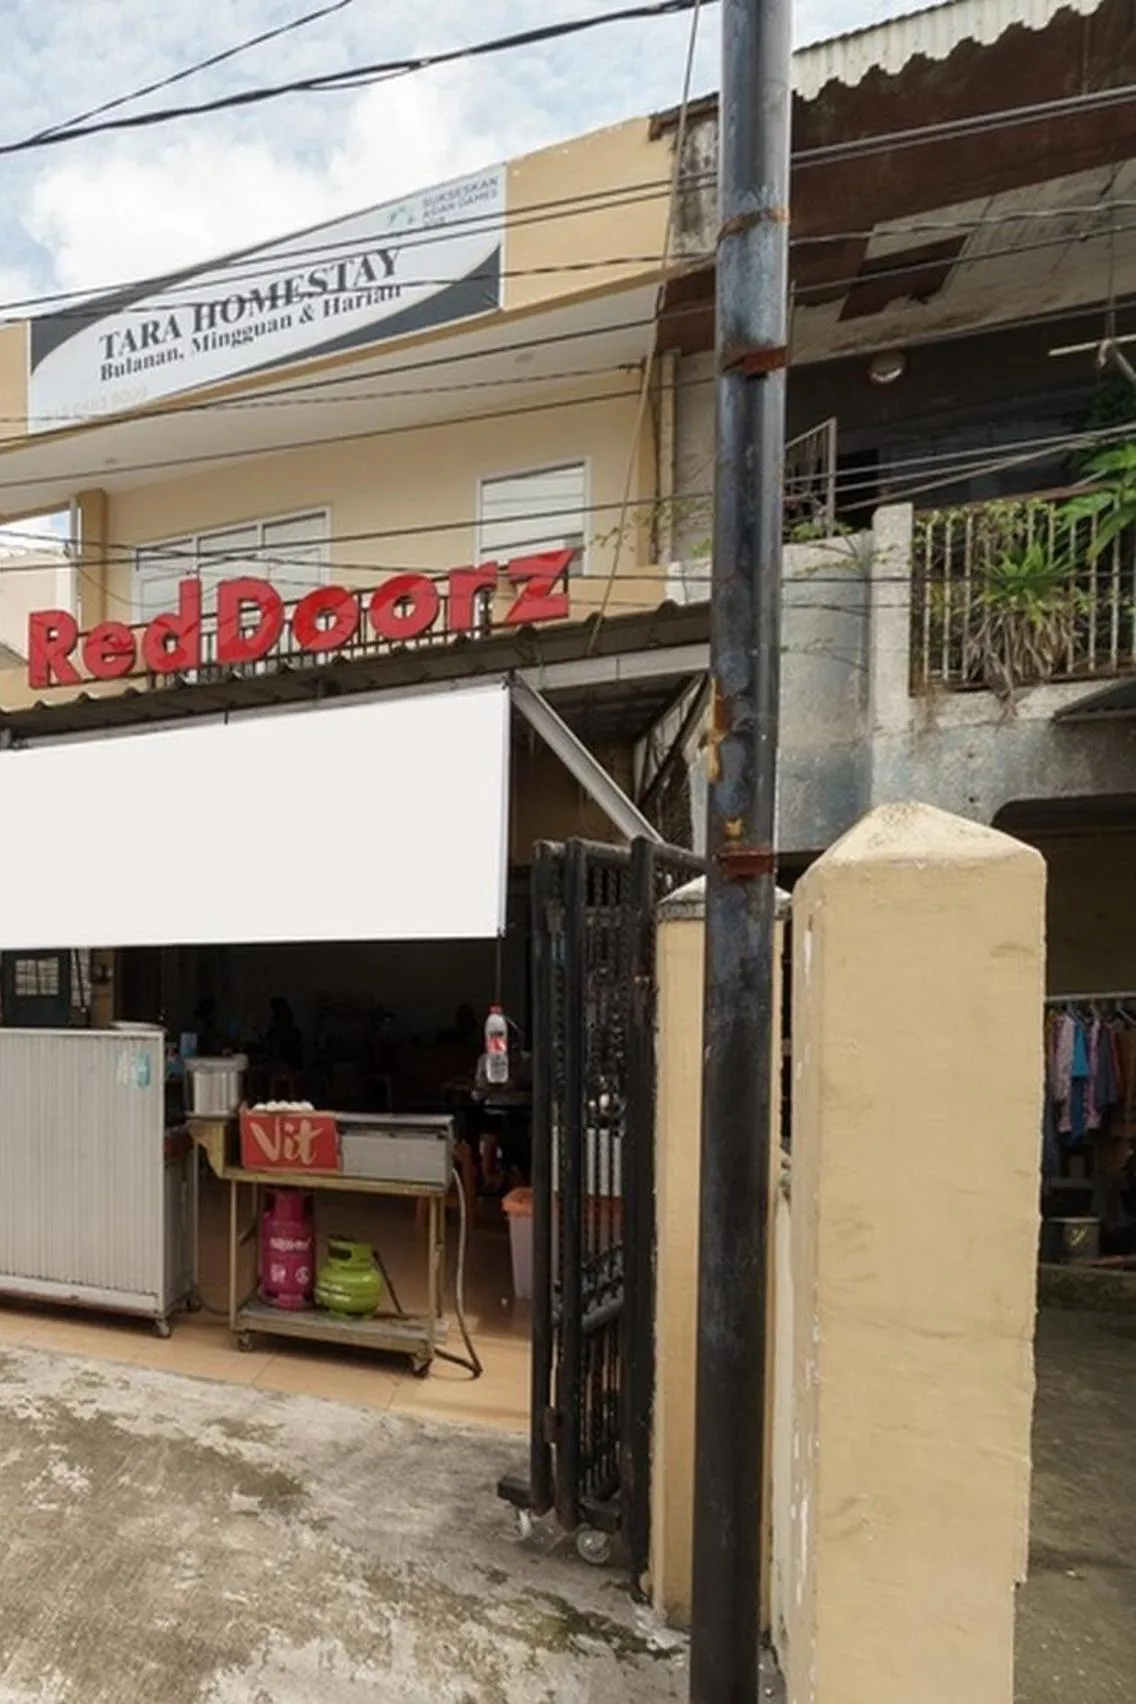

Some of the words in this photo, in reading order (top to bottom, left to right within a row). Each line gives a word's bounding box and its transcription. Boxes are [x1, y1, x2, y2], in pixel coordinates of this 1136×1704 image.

[99, 313, 182, 361] TARA
[191, 247, 402, 335] HOMESTAY
[100, 347, 184, 382] Bulanan,
[190, 313, 292, 354] Mingguan
[298, 303, 314, 325] &
[322, 285, 402, 318] Harian
[28, 547, 582, 691] RedDoorz
[248, 1115, 325, 1166] Vit
